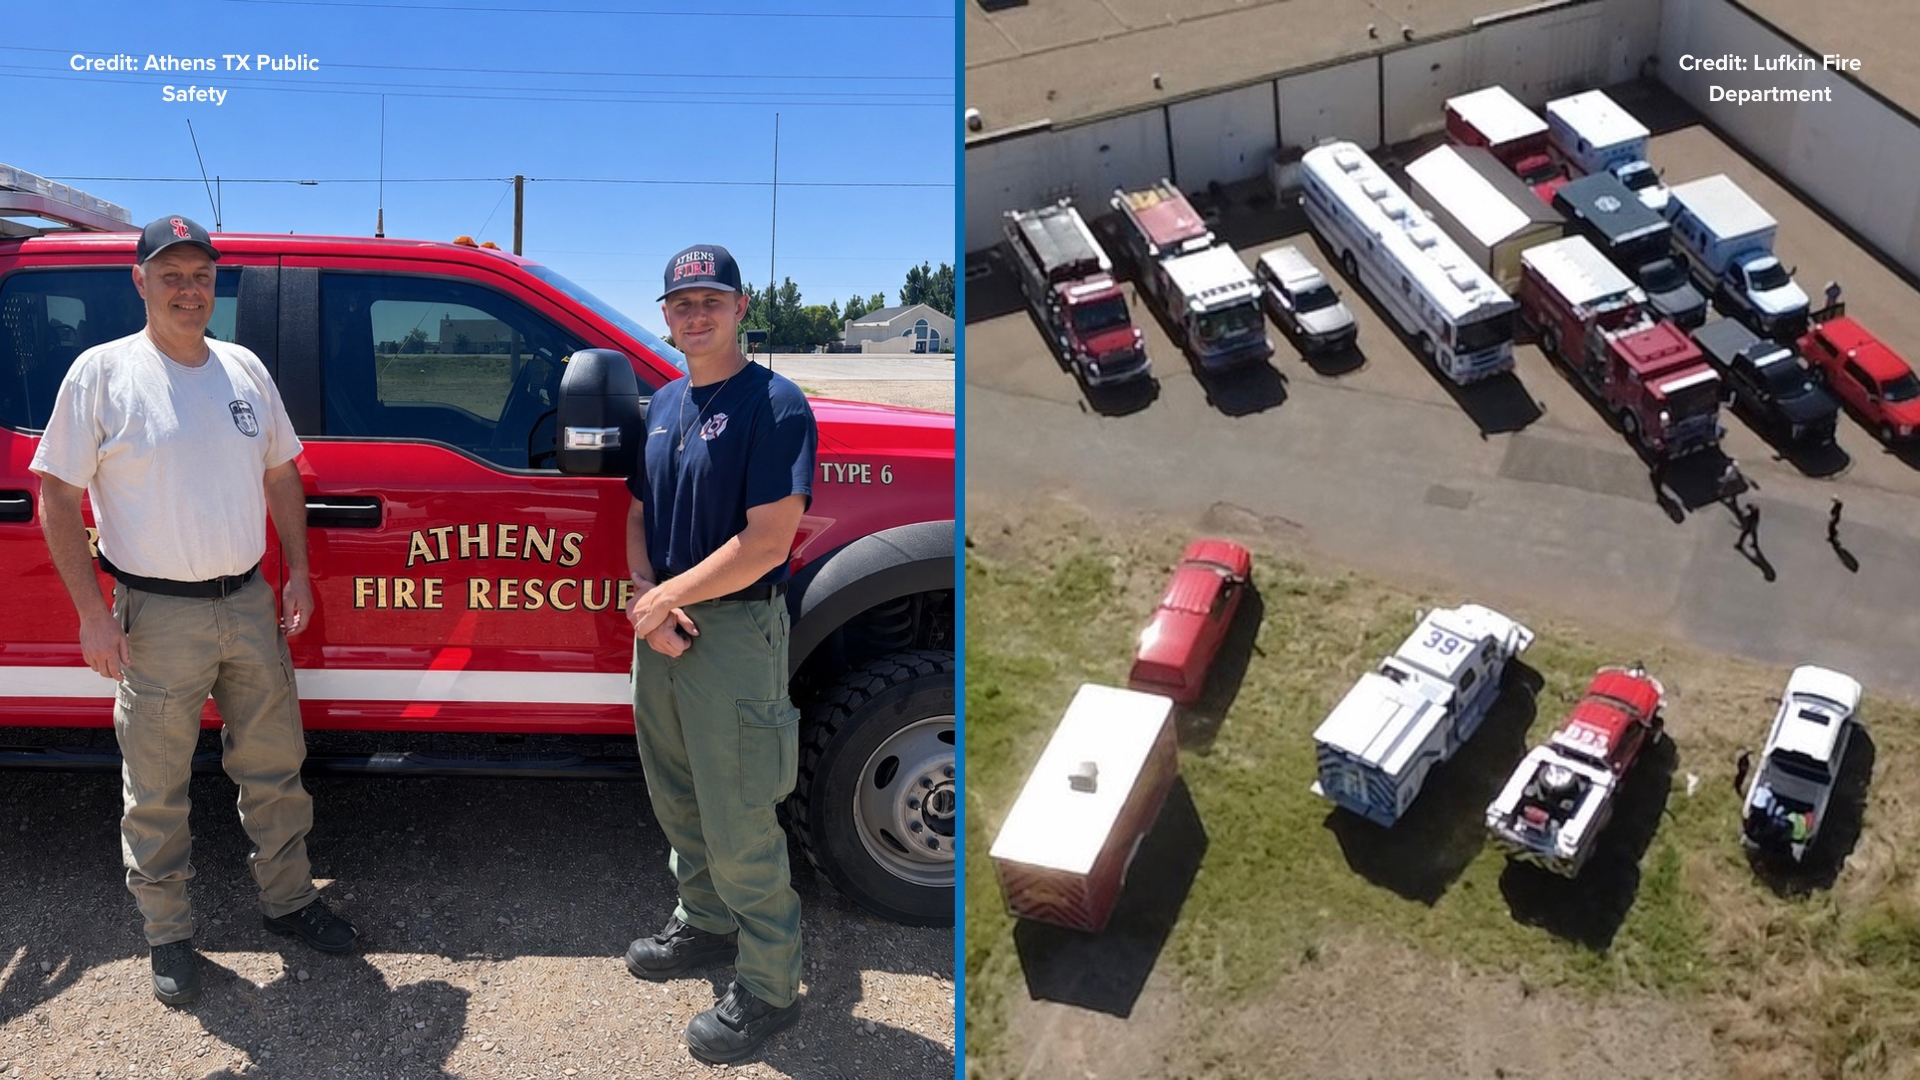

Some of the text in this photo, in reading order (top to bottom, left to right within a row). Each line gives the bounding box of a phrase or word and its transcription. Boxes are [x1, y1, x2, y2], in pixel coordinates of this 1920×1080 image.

[674, 250, 715, 267] ATHENS
[673, 261, 716, 282] FIRE
[820, 462, 894, 485] TYPE 6
[405, 523, 585, 568] ATHENS
[353, 577, 636, 612] FIRE RESCUE
